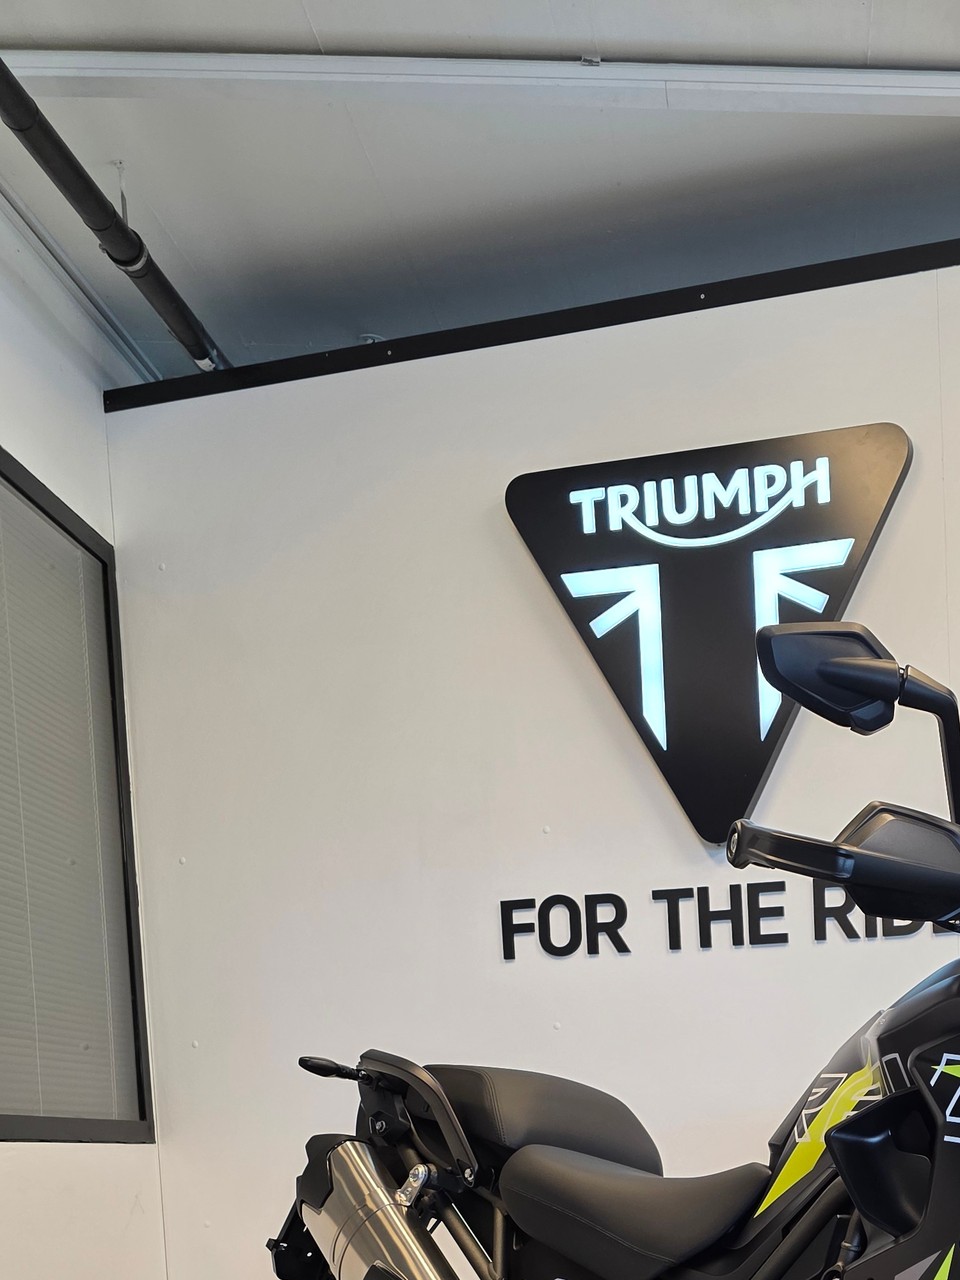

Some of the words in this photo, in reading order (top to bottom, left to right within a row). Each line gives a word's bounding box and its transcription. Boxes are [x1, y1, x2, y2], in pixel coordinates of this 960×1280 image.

[569, 457, 831, 547] TRIUMPH
[500, 893, 632, 960] FOR
[651, 880, 789, 951] THE
